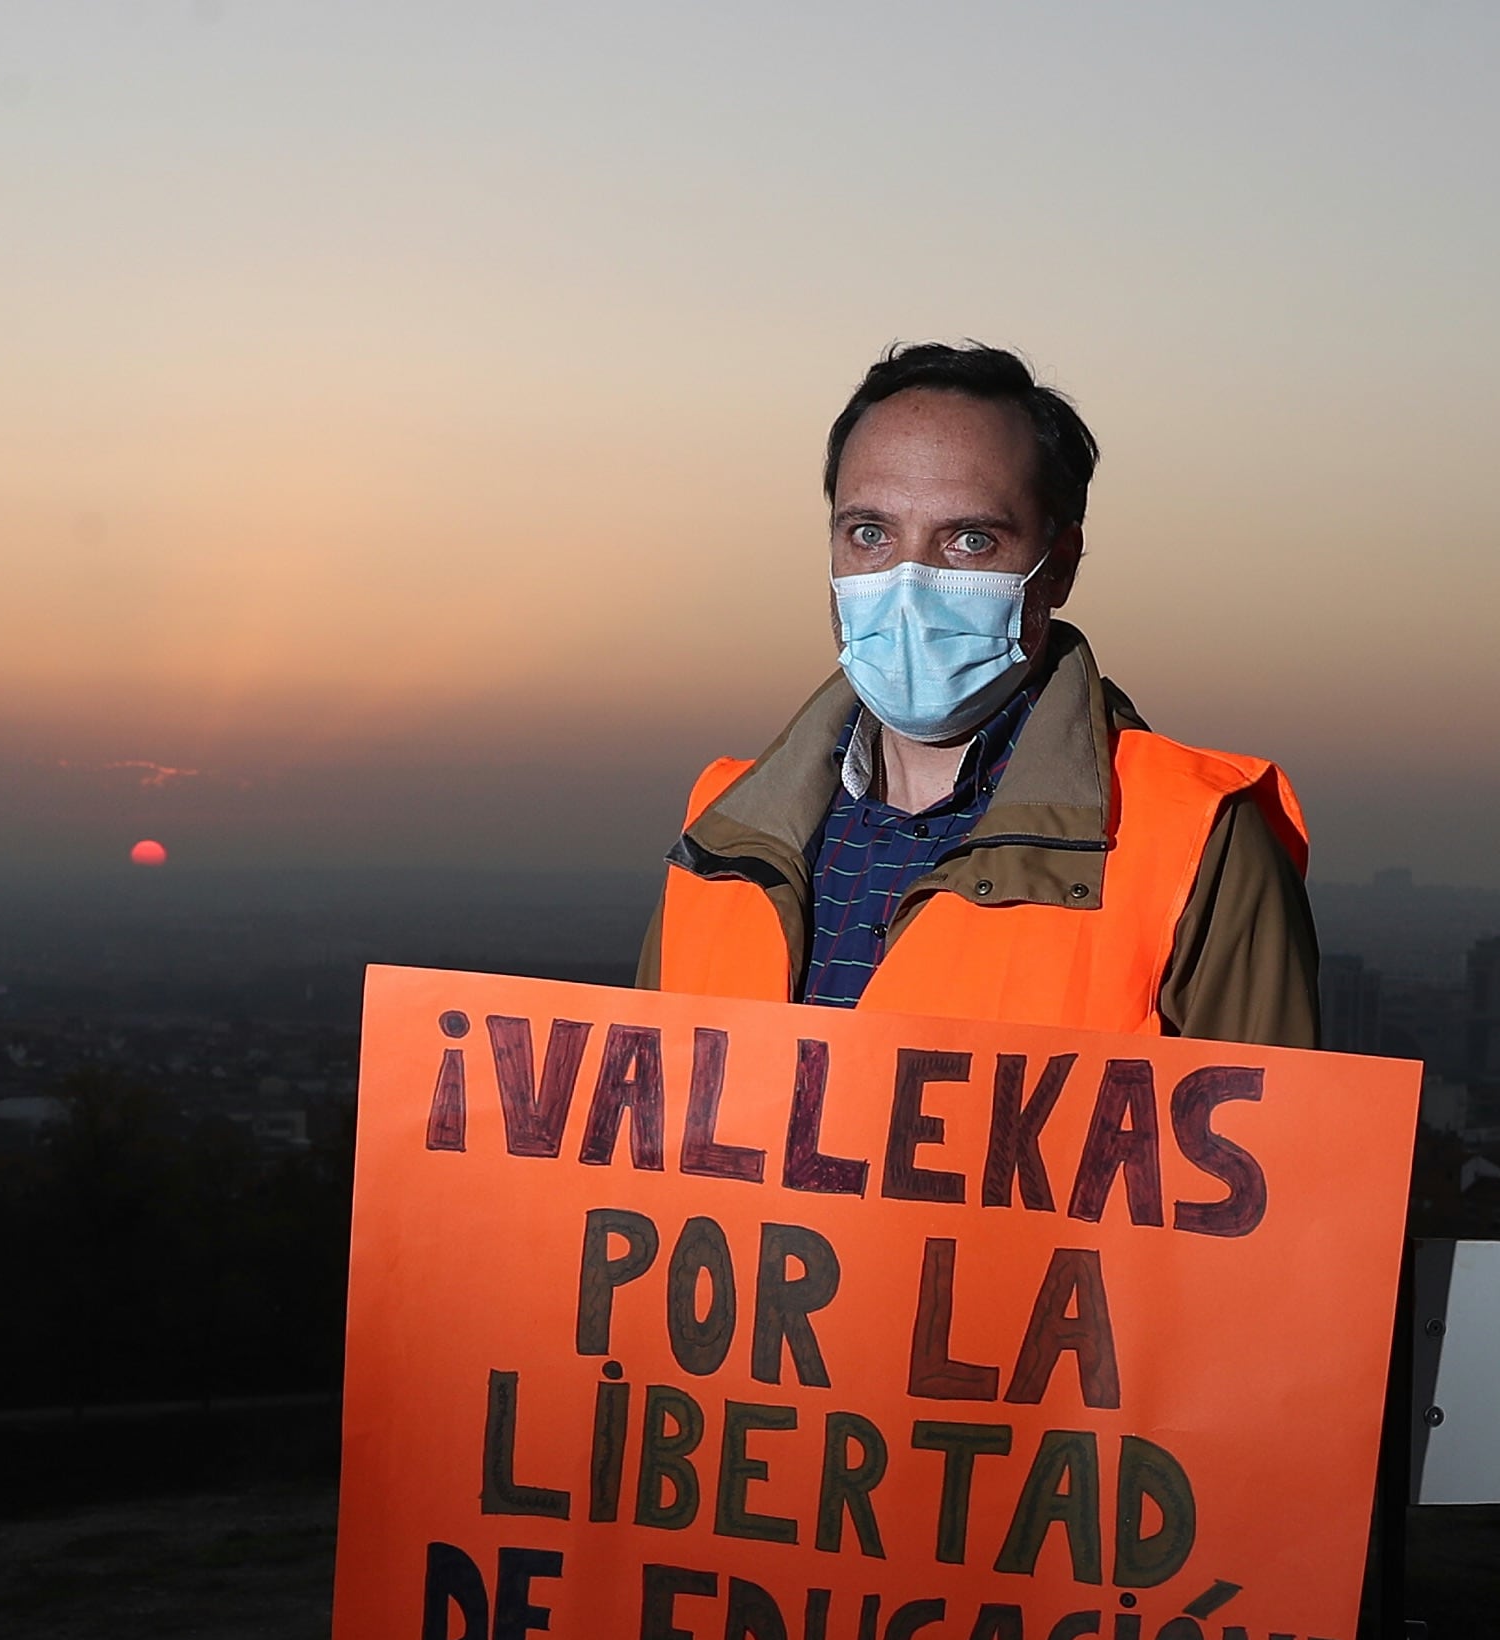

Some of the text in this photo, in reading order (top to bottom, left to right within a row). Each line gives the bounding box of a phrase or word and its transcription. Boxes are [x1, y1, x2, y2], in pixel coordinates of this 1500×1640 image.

[424, 1009, 1269, 1237] ¡VALLEKAS
[575, 1208, 1121, 1409] POR LA
